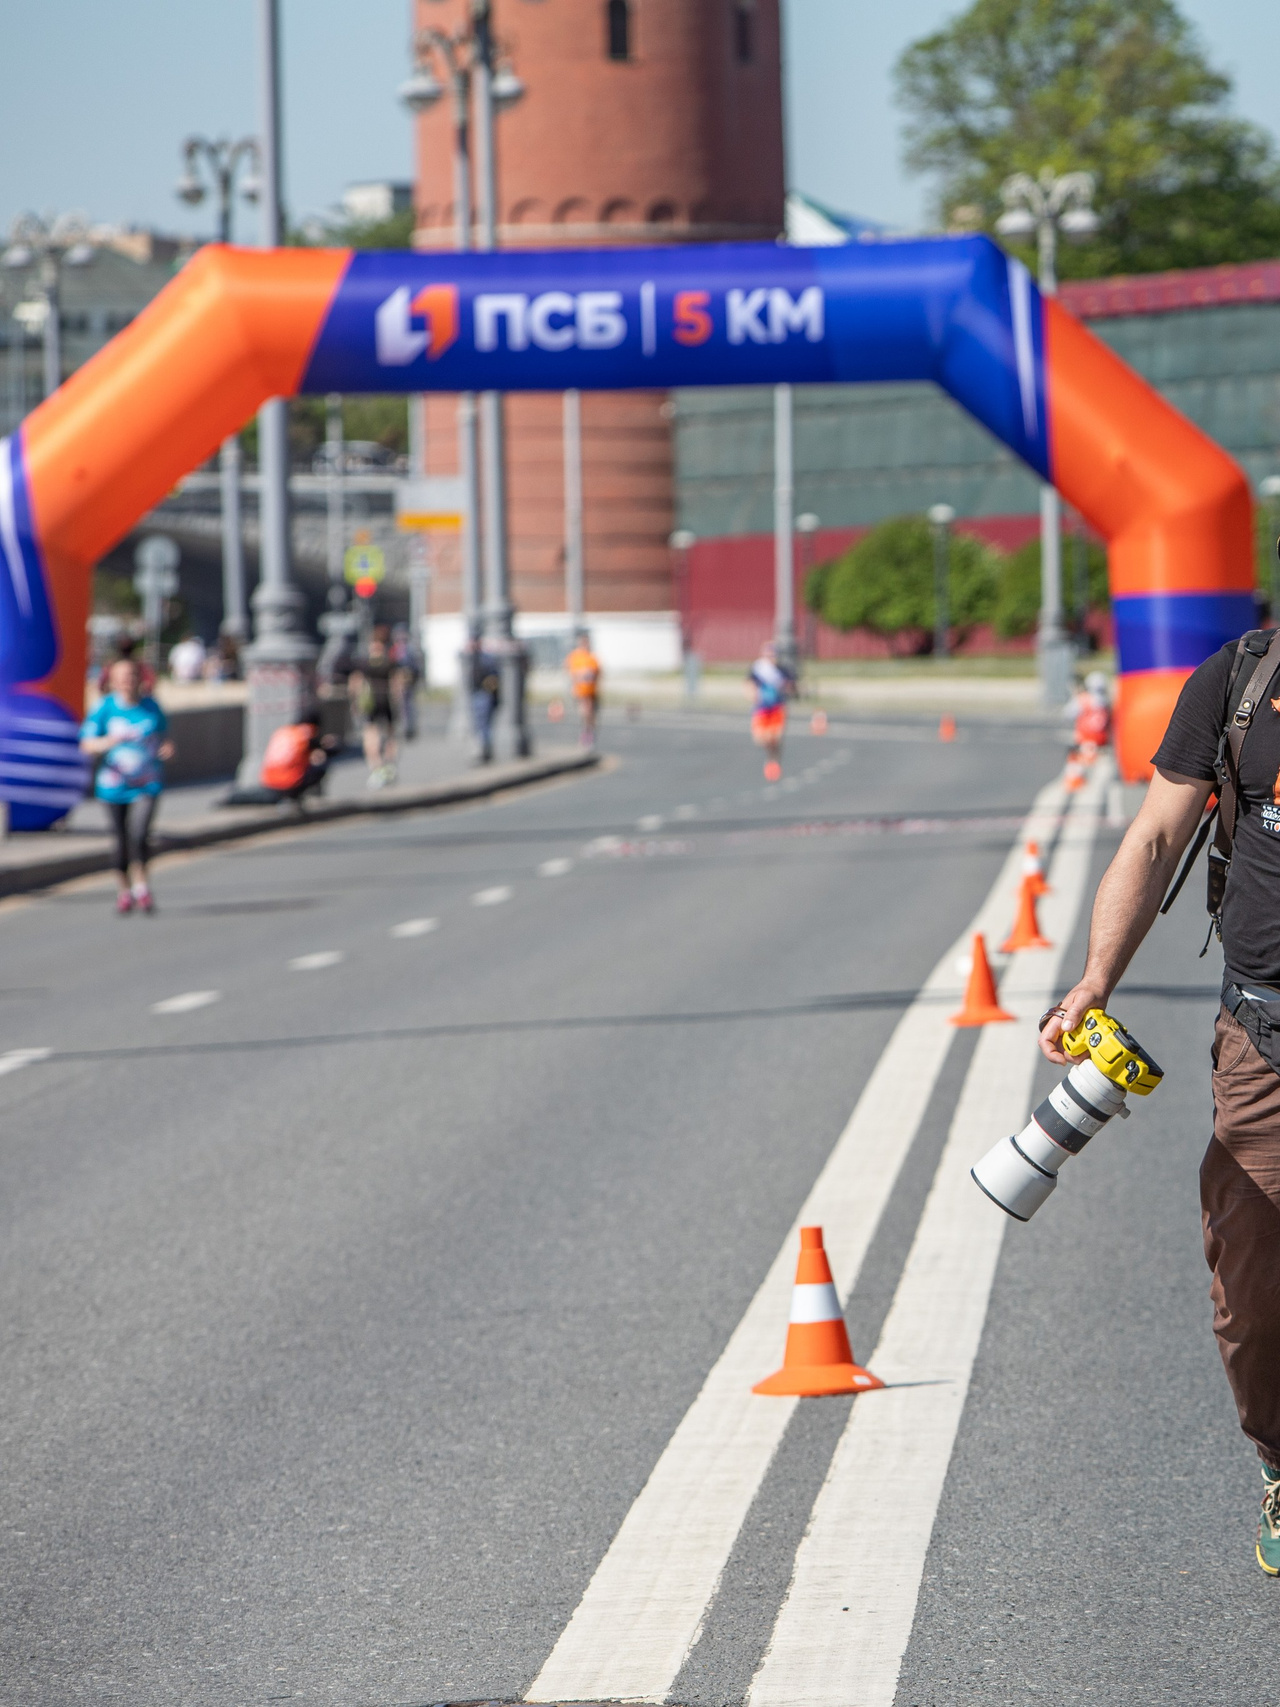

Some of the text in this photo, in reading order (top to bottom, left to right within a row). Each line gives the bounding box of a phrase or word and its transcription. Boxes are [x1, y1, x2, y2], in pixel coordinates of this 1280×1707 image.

[472, 285, 825, 352] ПСБ 5 КМ
